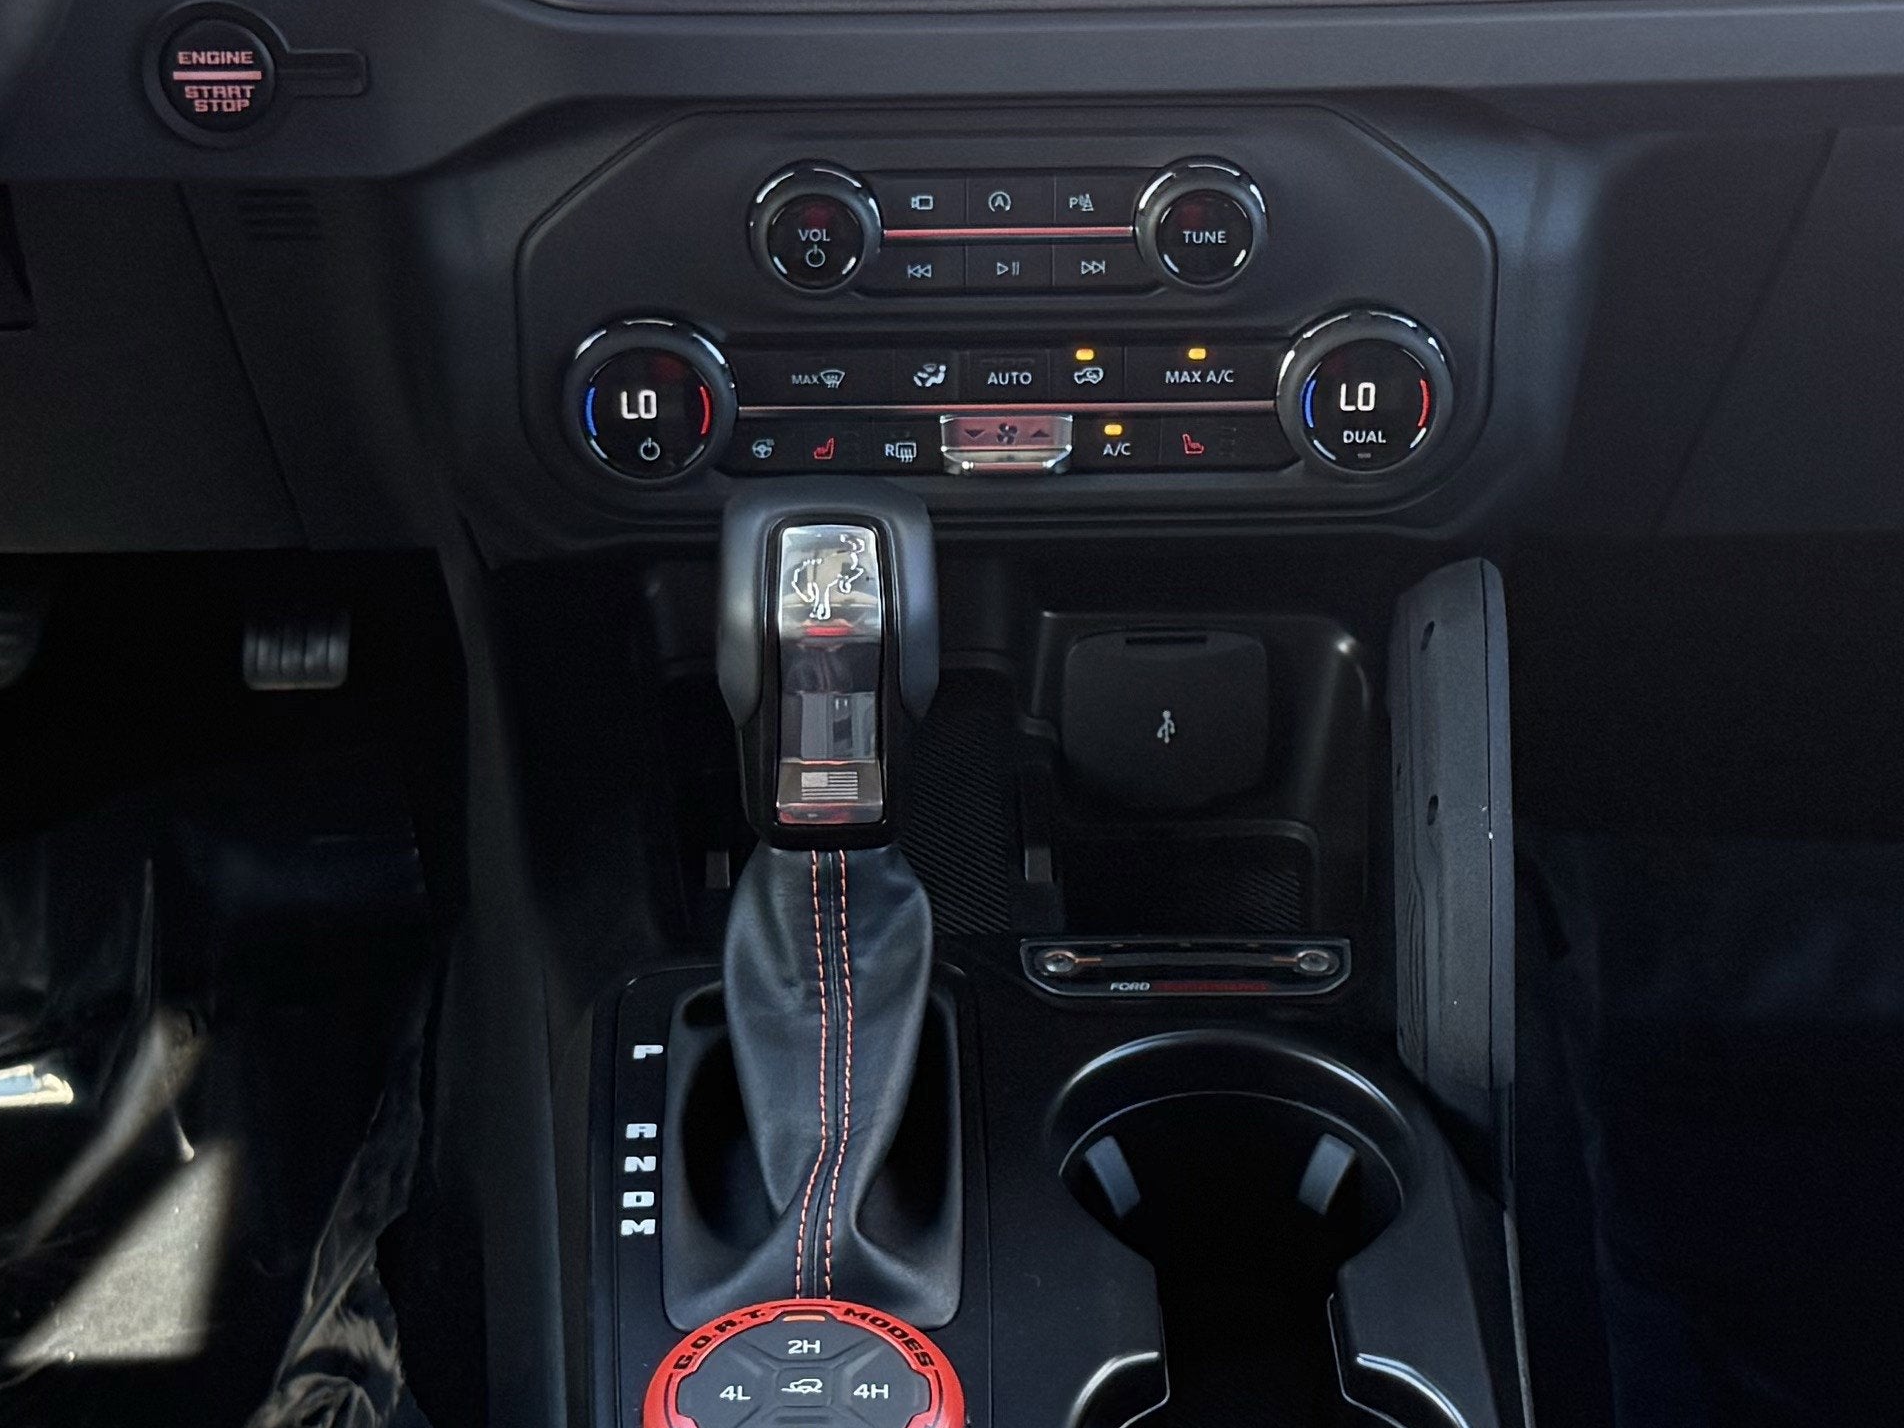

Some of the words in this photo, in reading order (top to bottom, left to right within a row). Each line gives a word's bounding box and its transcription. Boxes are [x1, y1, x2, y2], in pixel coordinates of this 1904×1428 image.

[177, 51, 253, 64] ENGINE
[185, 86, 255, 98] START
[194, 99, 250, 113] STOP
[798, 229, 830, 242] VOL
[1182, 231, 1226, 244] TUNE
[791, 374, 819, 386] MAX
[987, 372, 1032, 386] AUTO
[1165, 371, 1200, 384] MAX
[1205, 369, 1234, 385] A/C
[620, 389, 657, 420] LO
[1339, 382, 1376, 412] LO
[1343, 431, 1387, 445] DUAL
[1103, 442, 1131, 458] A/C
[1109, 981, 1151, 992] FORD
[632, 1043, 664, 1060] P
[624, 1155, 657, 1172] N
[622, 1190, 655, 1208] D
[620, 1218, 656, 1236] M
[673, 1308, 767, 1371] G.O.A.T.
[843, 1307, 936, 1368] MODES
[787, 1339, 821, 1355] 2H
[719, 1385, 751, 1401] 4L
[853, 1383, 889, 1400] 4H
